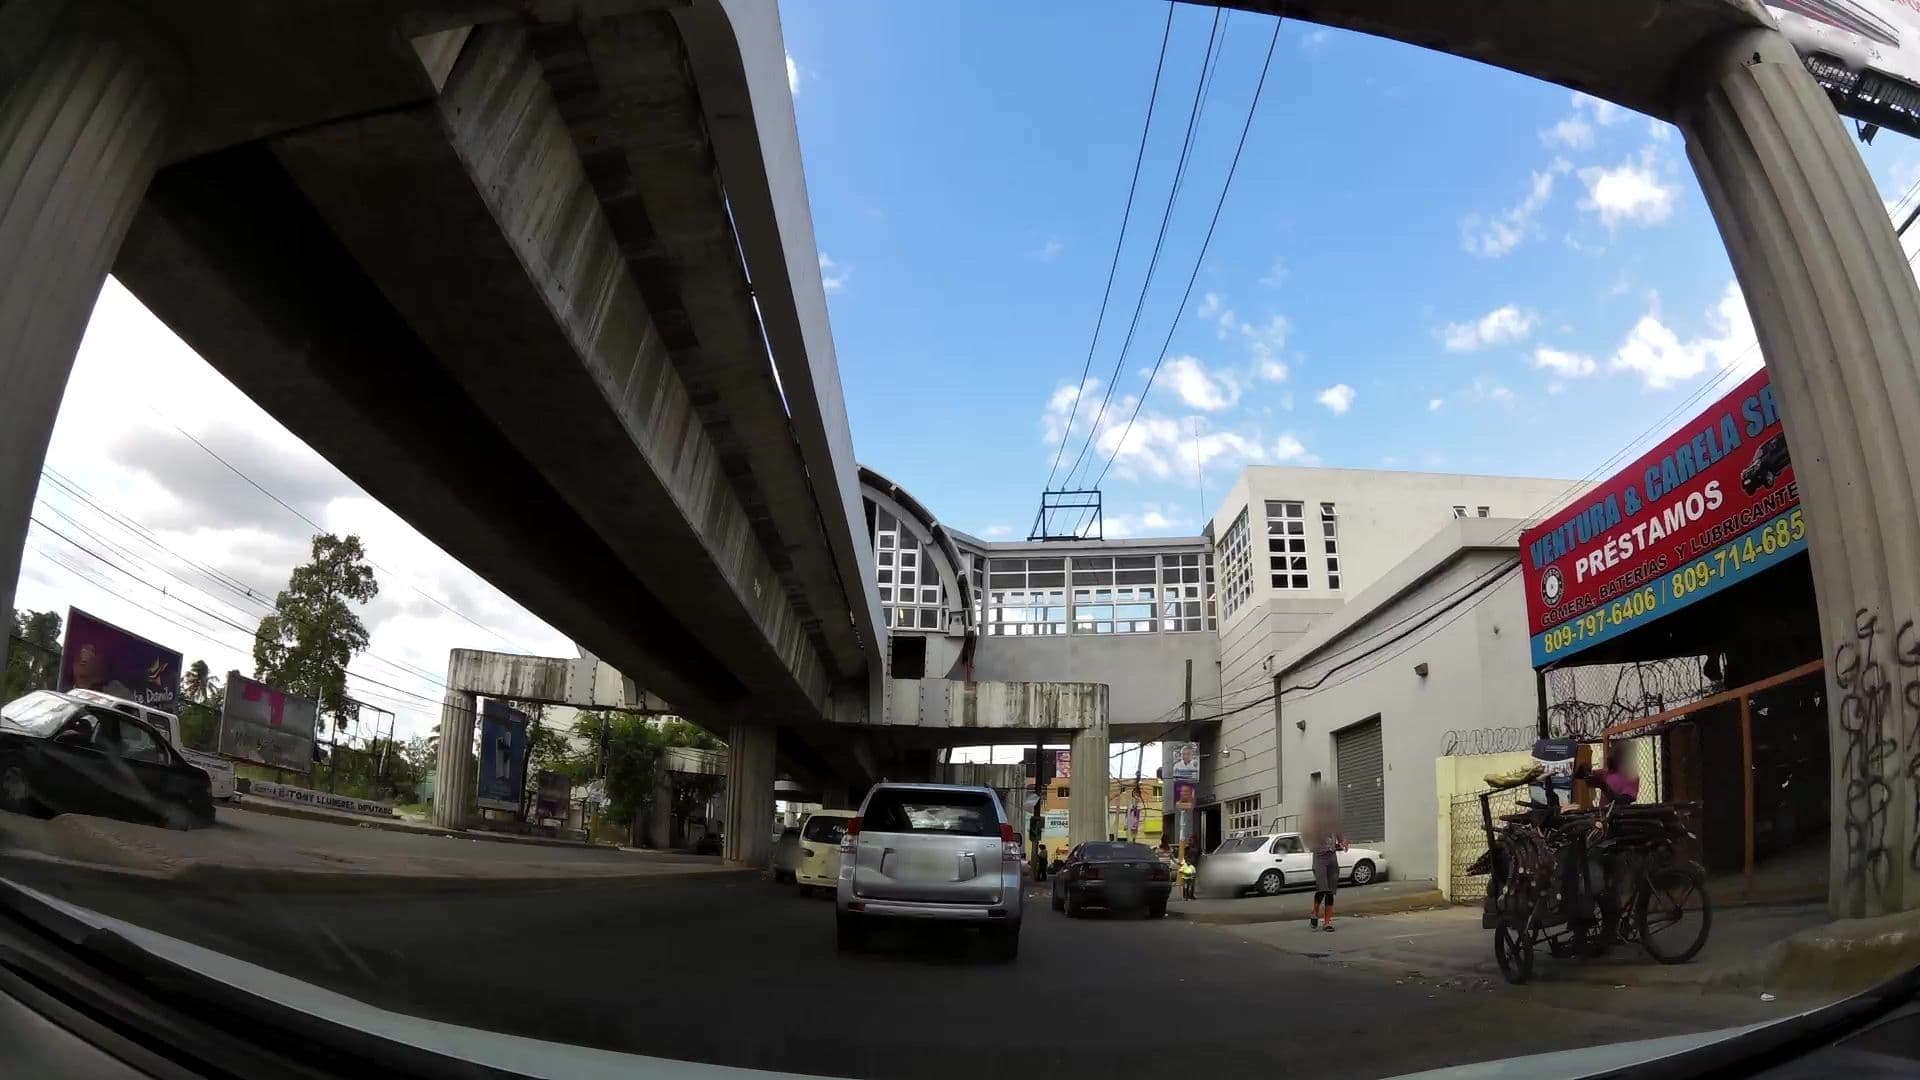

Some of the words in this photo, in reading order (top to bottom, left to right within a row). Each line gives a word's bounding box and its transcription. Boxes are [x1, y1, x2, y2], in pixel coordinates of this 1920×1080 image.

[1530, 493, 1621, 570] VENTURA
[1624, 486, 1643, 517] &
[1644, 412, 1743, 502] CARELA
[1575, 480, 1723, 584] PRÉSTAMOS
[1674, 541, 1688, 561] Y
[1689, 481, 1800, 555] LUBRICANTE
[1544, 586, 1656, 654] 809-797-6406
[1672, 510, 1806, 598] 809-714-685
